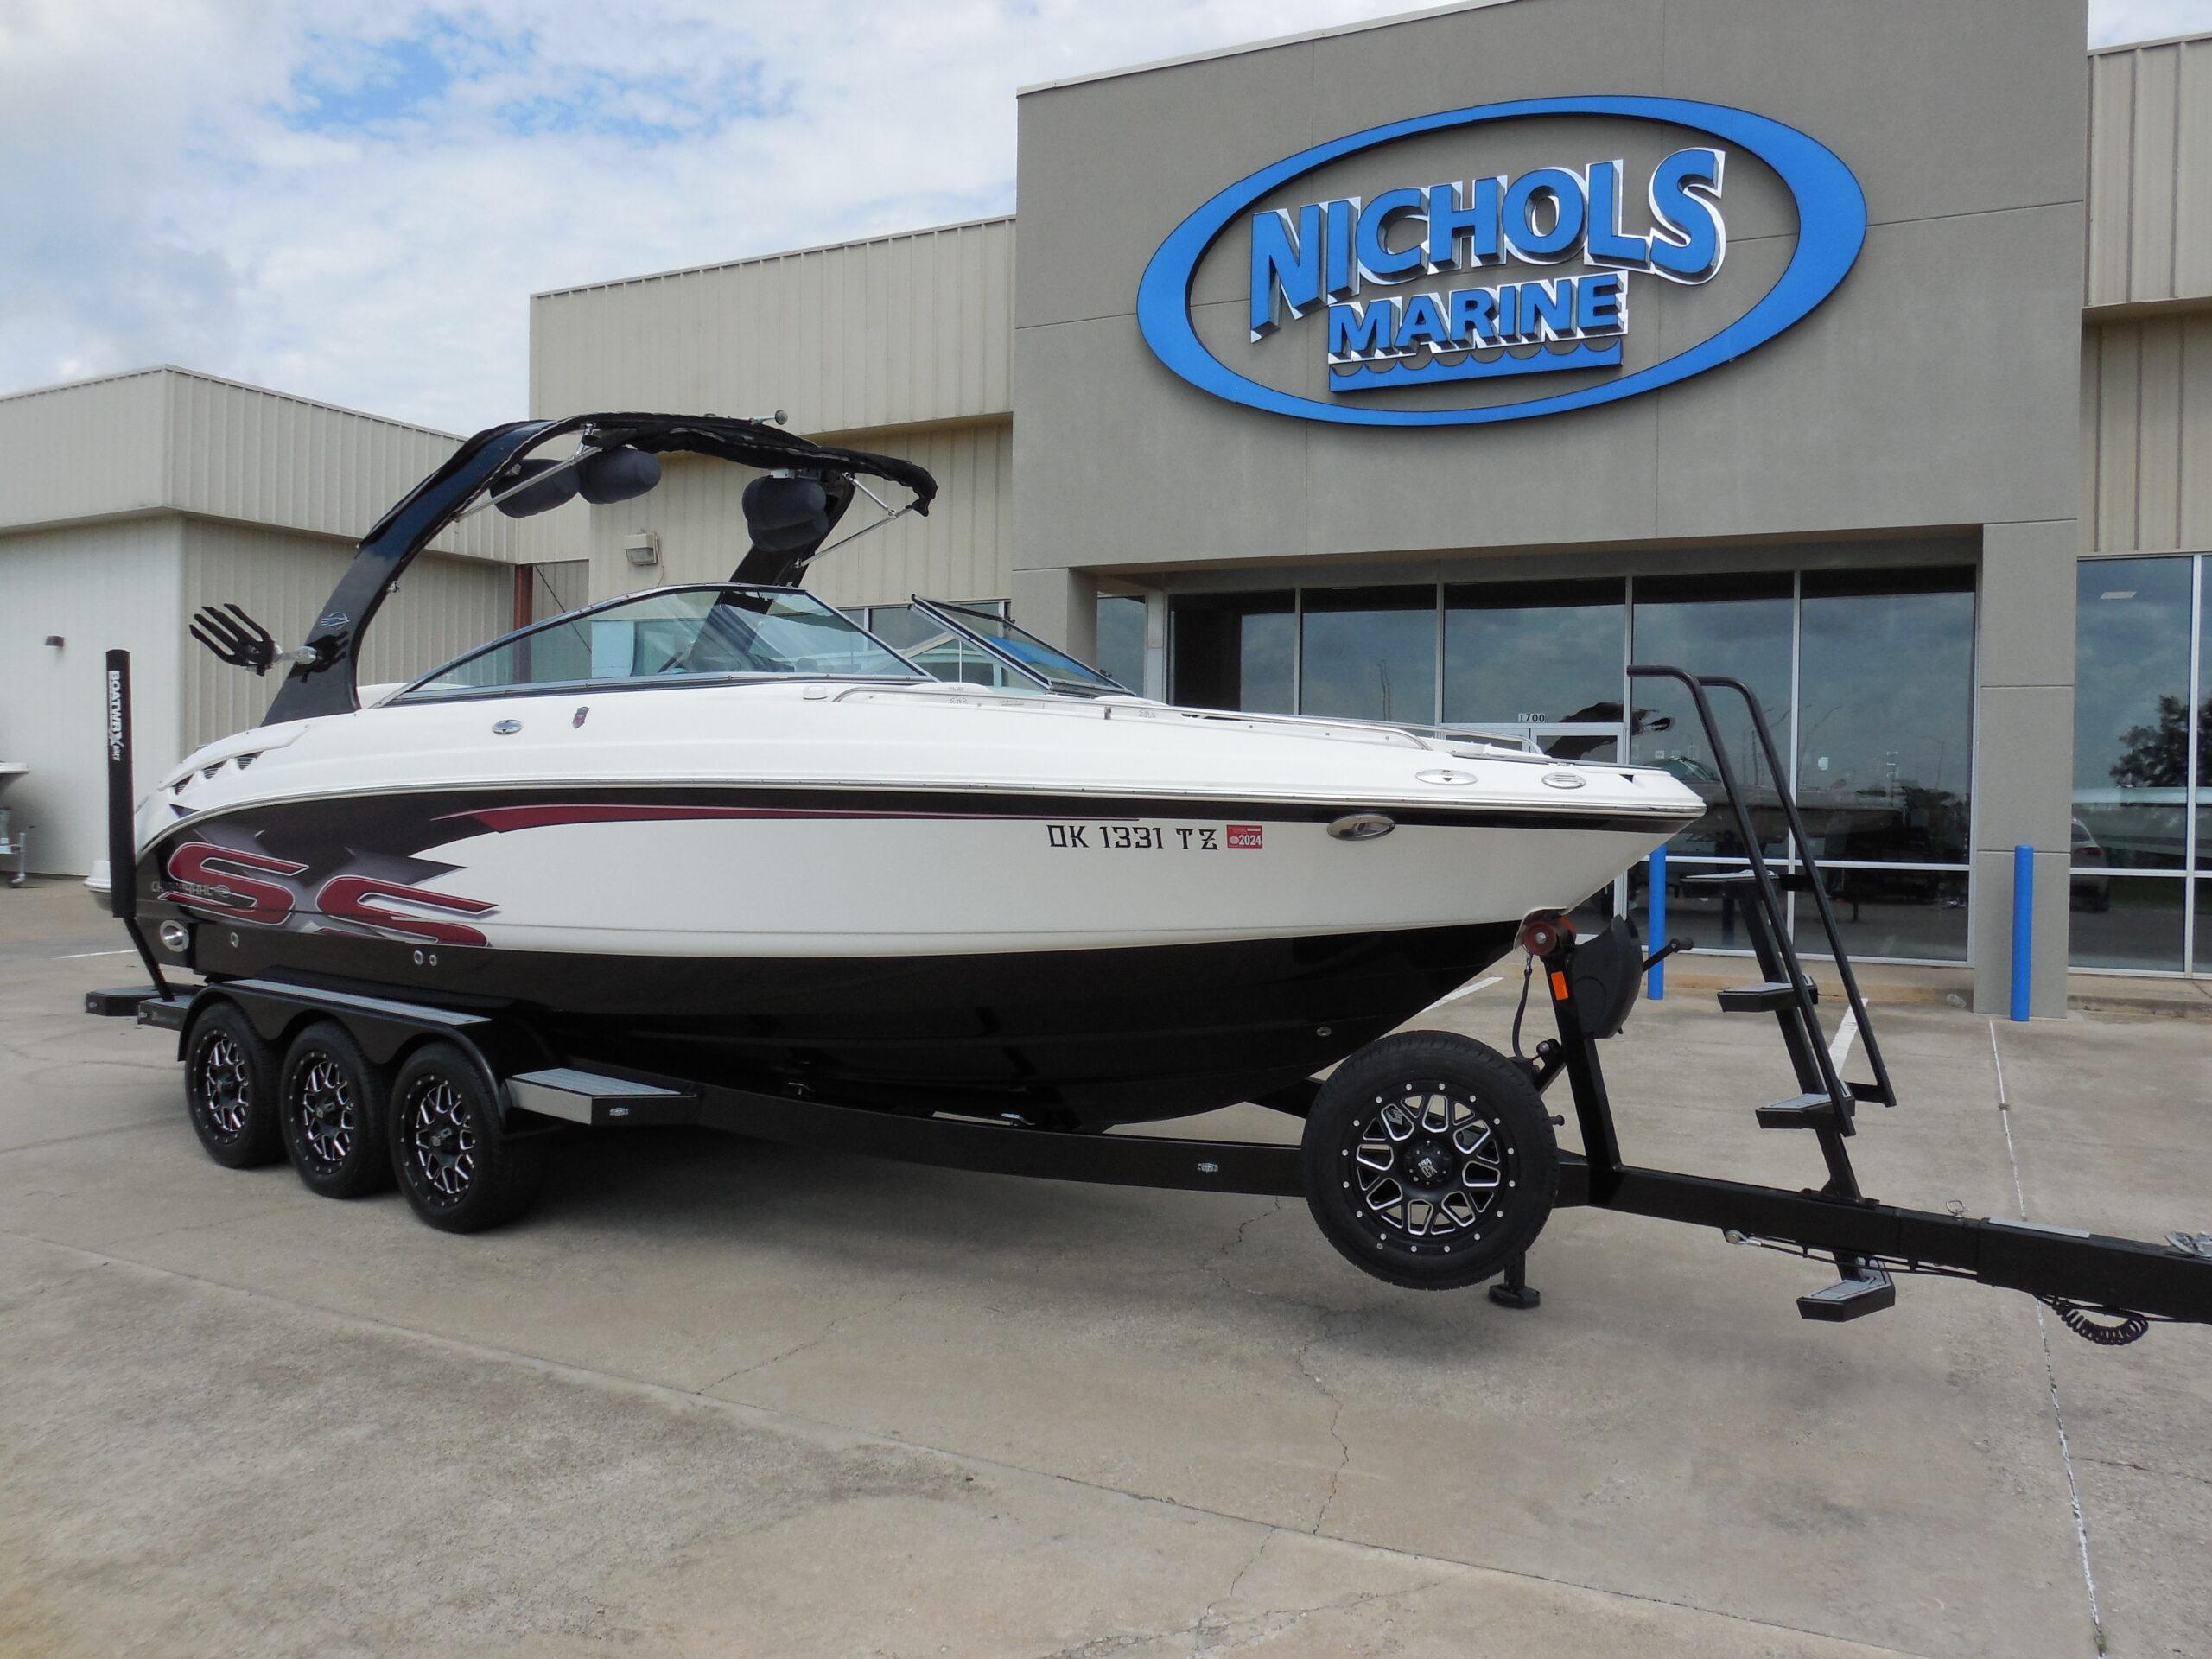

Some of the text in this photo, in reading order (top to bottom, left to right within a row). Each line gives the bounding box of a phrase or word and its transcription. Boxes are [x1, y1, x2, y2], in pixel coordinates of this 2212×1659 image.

[1250, 147, 1726, 343] NICHOLS
[1327, 270, 1629, 365] MARINE
[1520, 714, 1545, 722] 1700
[1046, 824, 1219, 851] OK 1331 TZ
[1238, 834, 1262, 846] 2024
